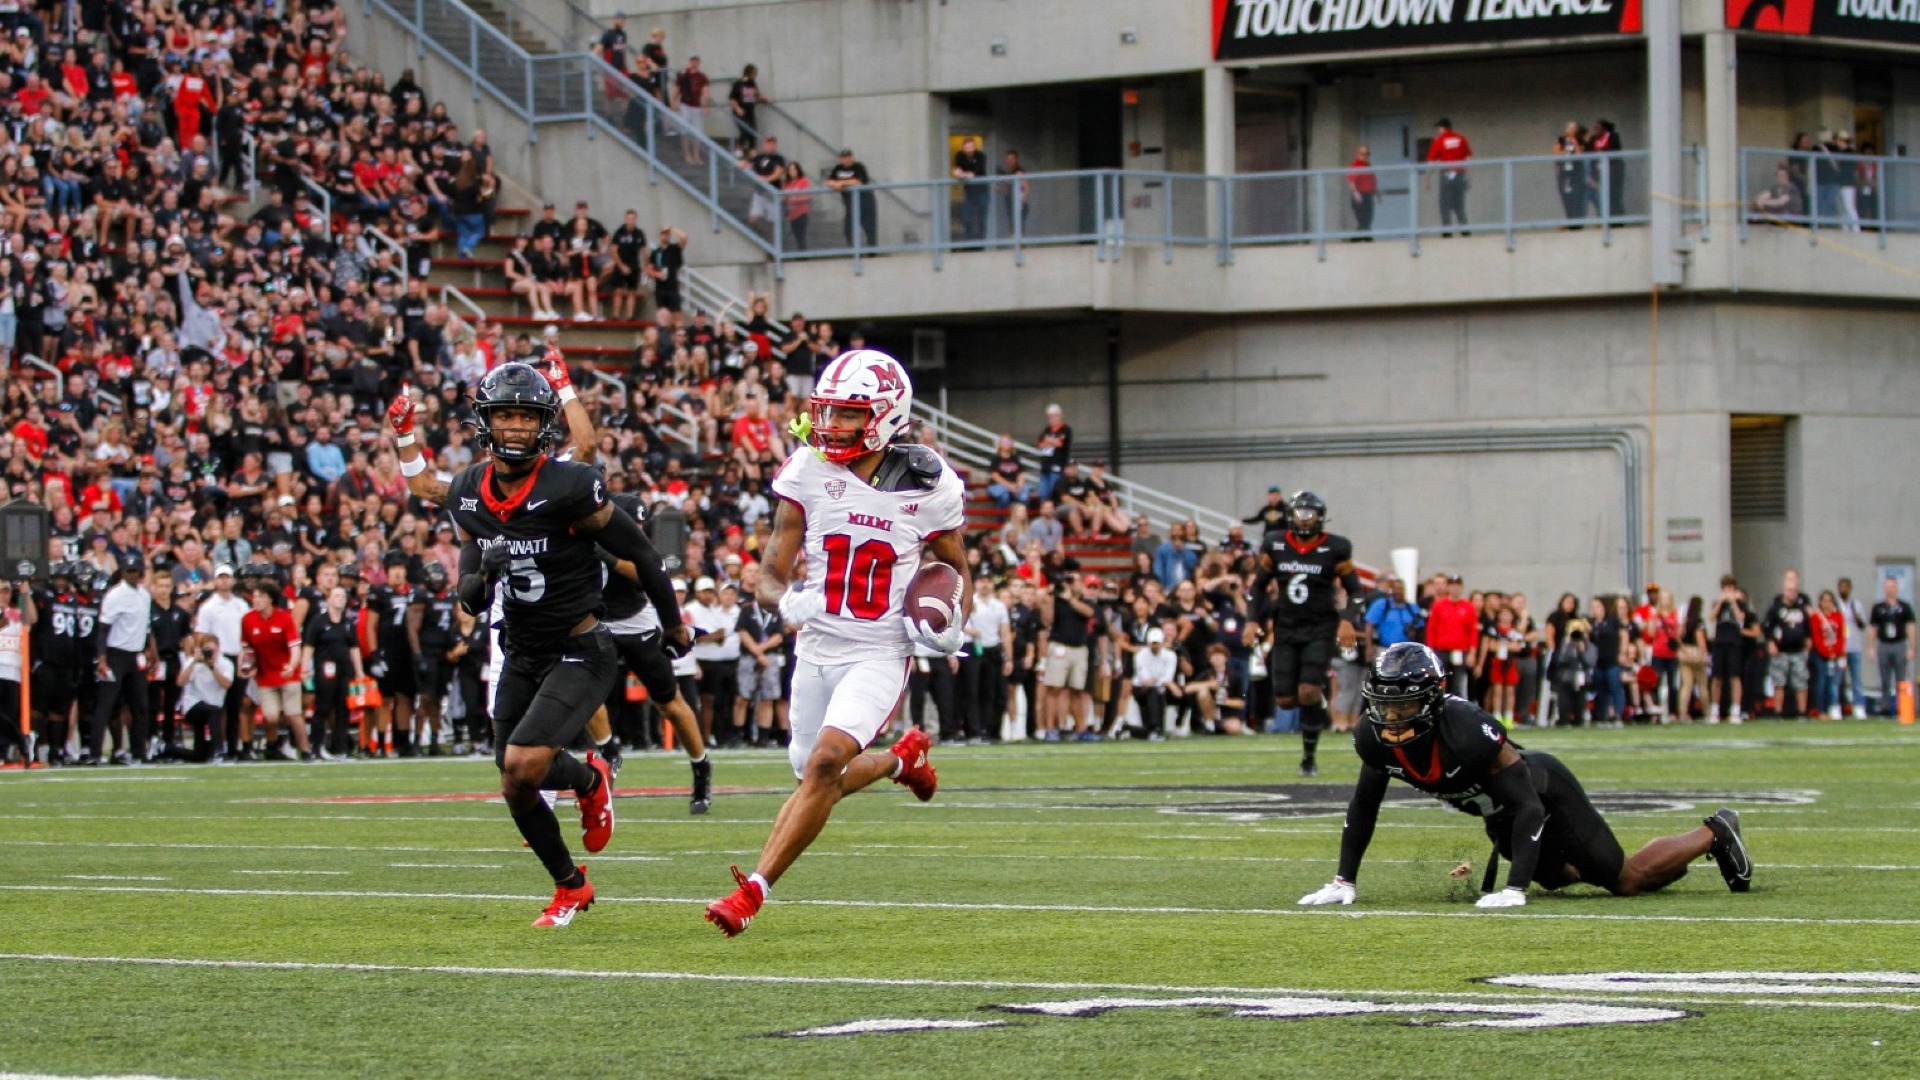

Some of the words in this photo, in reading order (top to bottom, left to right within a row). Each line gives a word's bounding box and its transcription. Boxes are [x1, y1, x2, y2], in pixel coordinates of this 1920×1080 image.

[1234, 0, 1460, 39] TOUCHDOWN
[847, 511, 894, 532] MIAMI
[476, 534, 549, 555] CINNNATI
[822, 533, 899, 621] 10
[1287, 573, 1309, 605] 6
